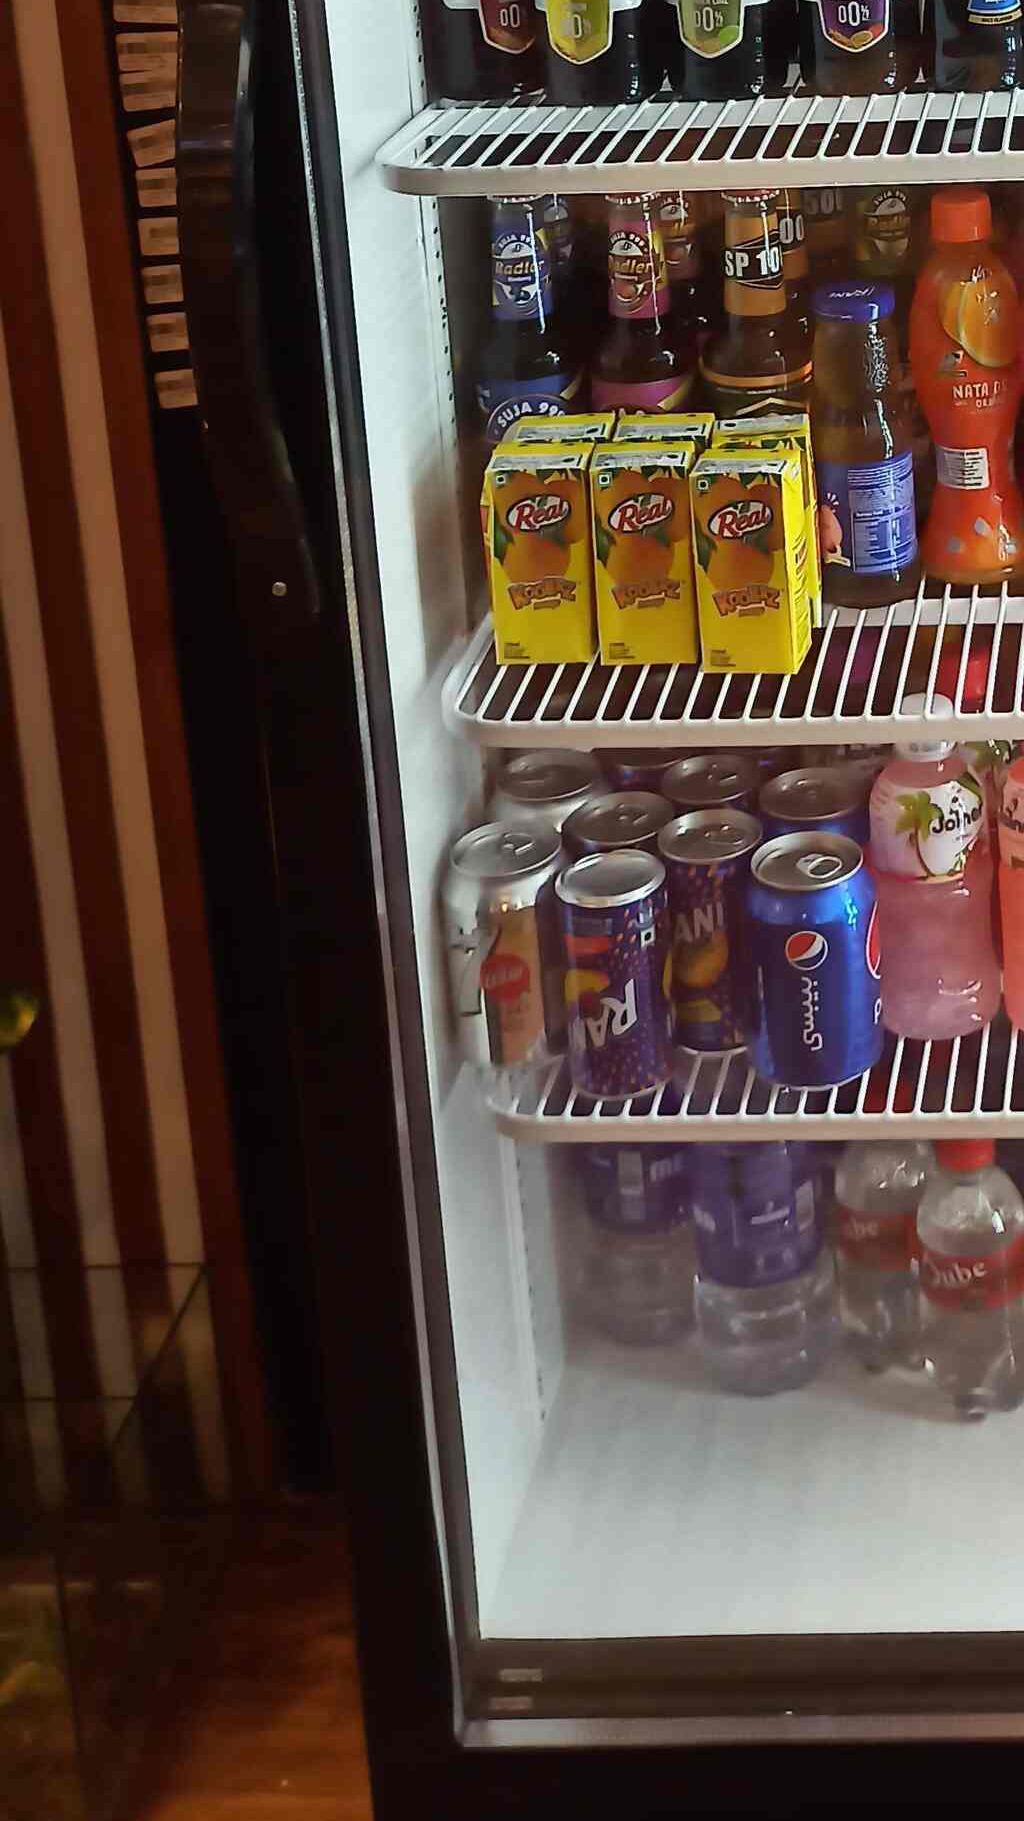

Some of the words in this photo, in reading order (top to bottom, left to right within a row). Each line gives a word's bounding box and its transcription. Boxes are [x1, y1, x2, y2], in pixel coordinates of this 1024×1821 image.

[724, 250, 750, 277] SP
[756, 245, 784, 276] 10
[952, 382, 989, 400] NATA
[498, 401, 534, 430] SUJA
[515, 497, 570, 532] Real
[616, 496, 672, 532] Real
[716, 503, 772, 539] Real
